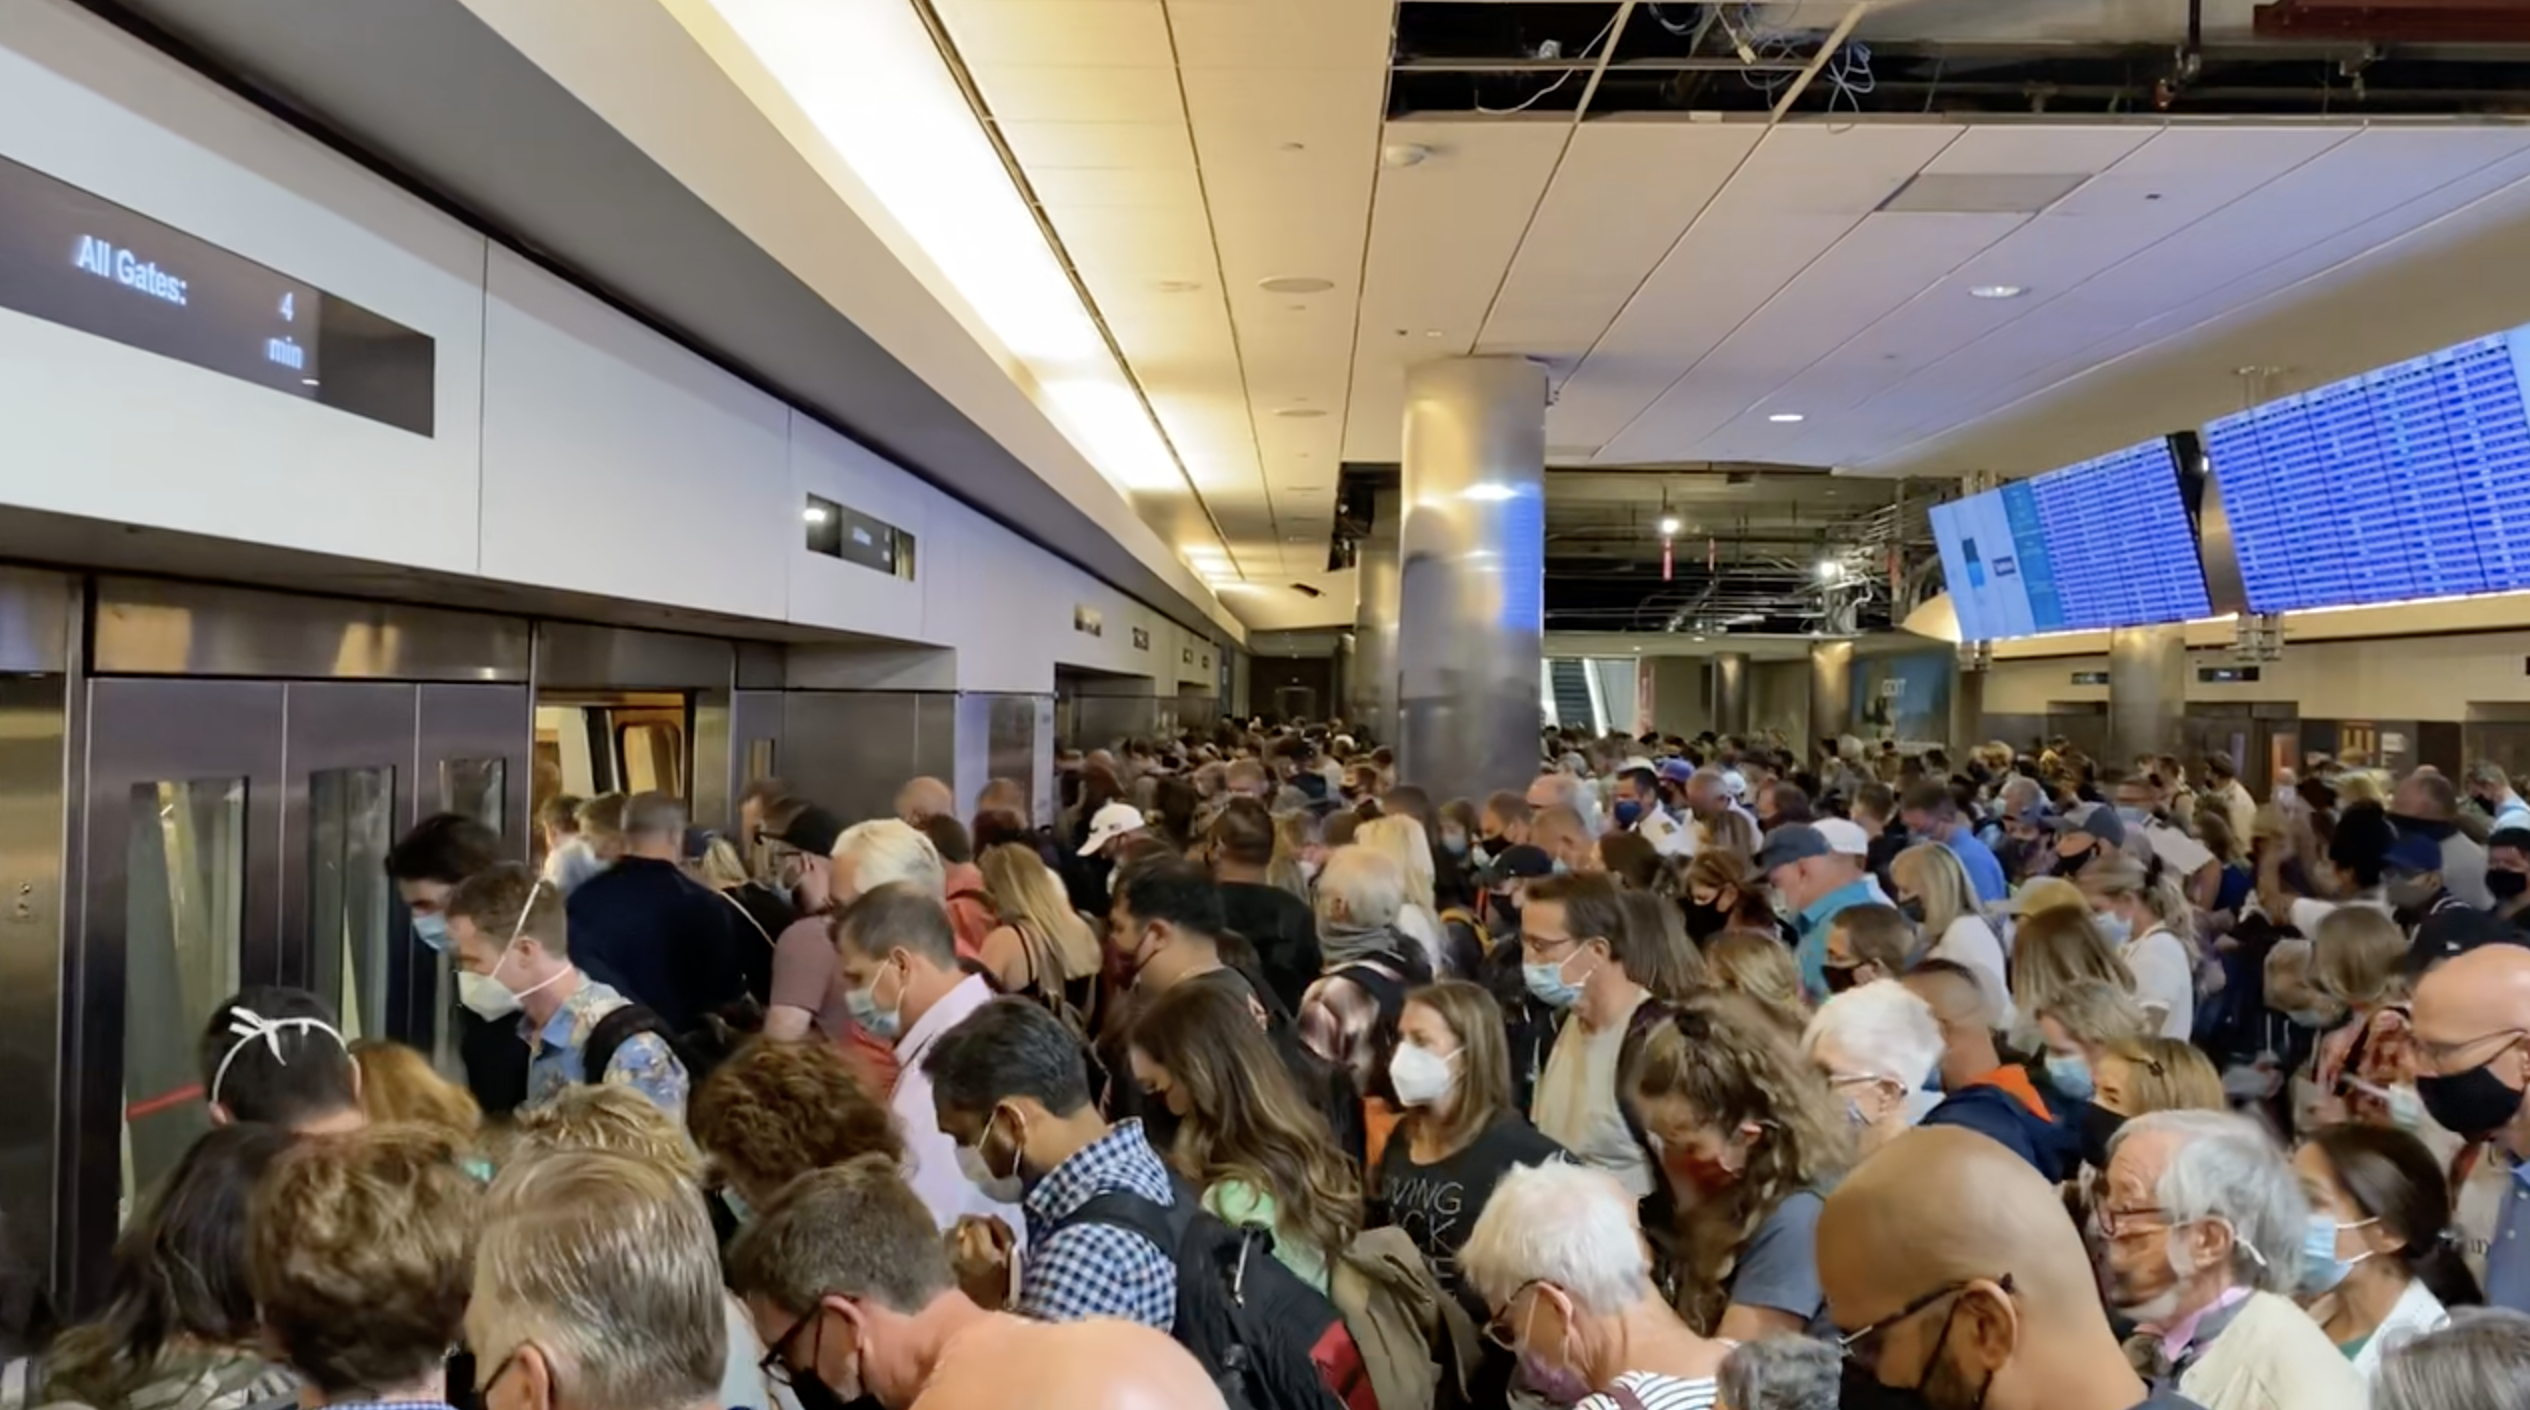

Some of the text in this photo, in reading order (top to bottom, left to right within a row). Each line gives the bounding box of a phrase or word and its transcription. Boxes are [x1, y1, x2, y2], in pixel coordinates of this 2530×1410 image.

[76, 234, 188, 306] All Gates:
[280, 291, 294, 322] 4
[268, 335, 303, 370] min
[1384, 1175, 1464, 1215] VING
